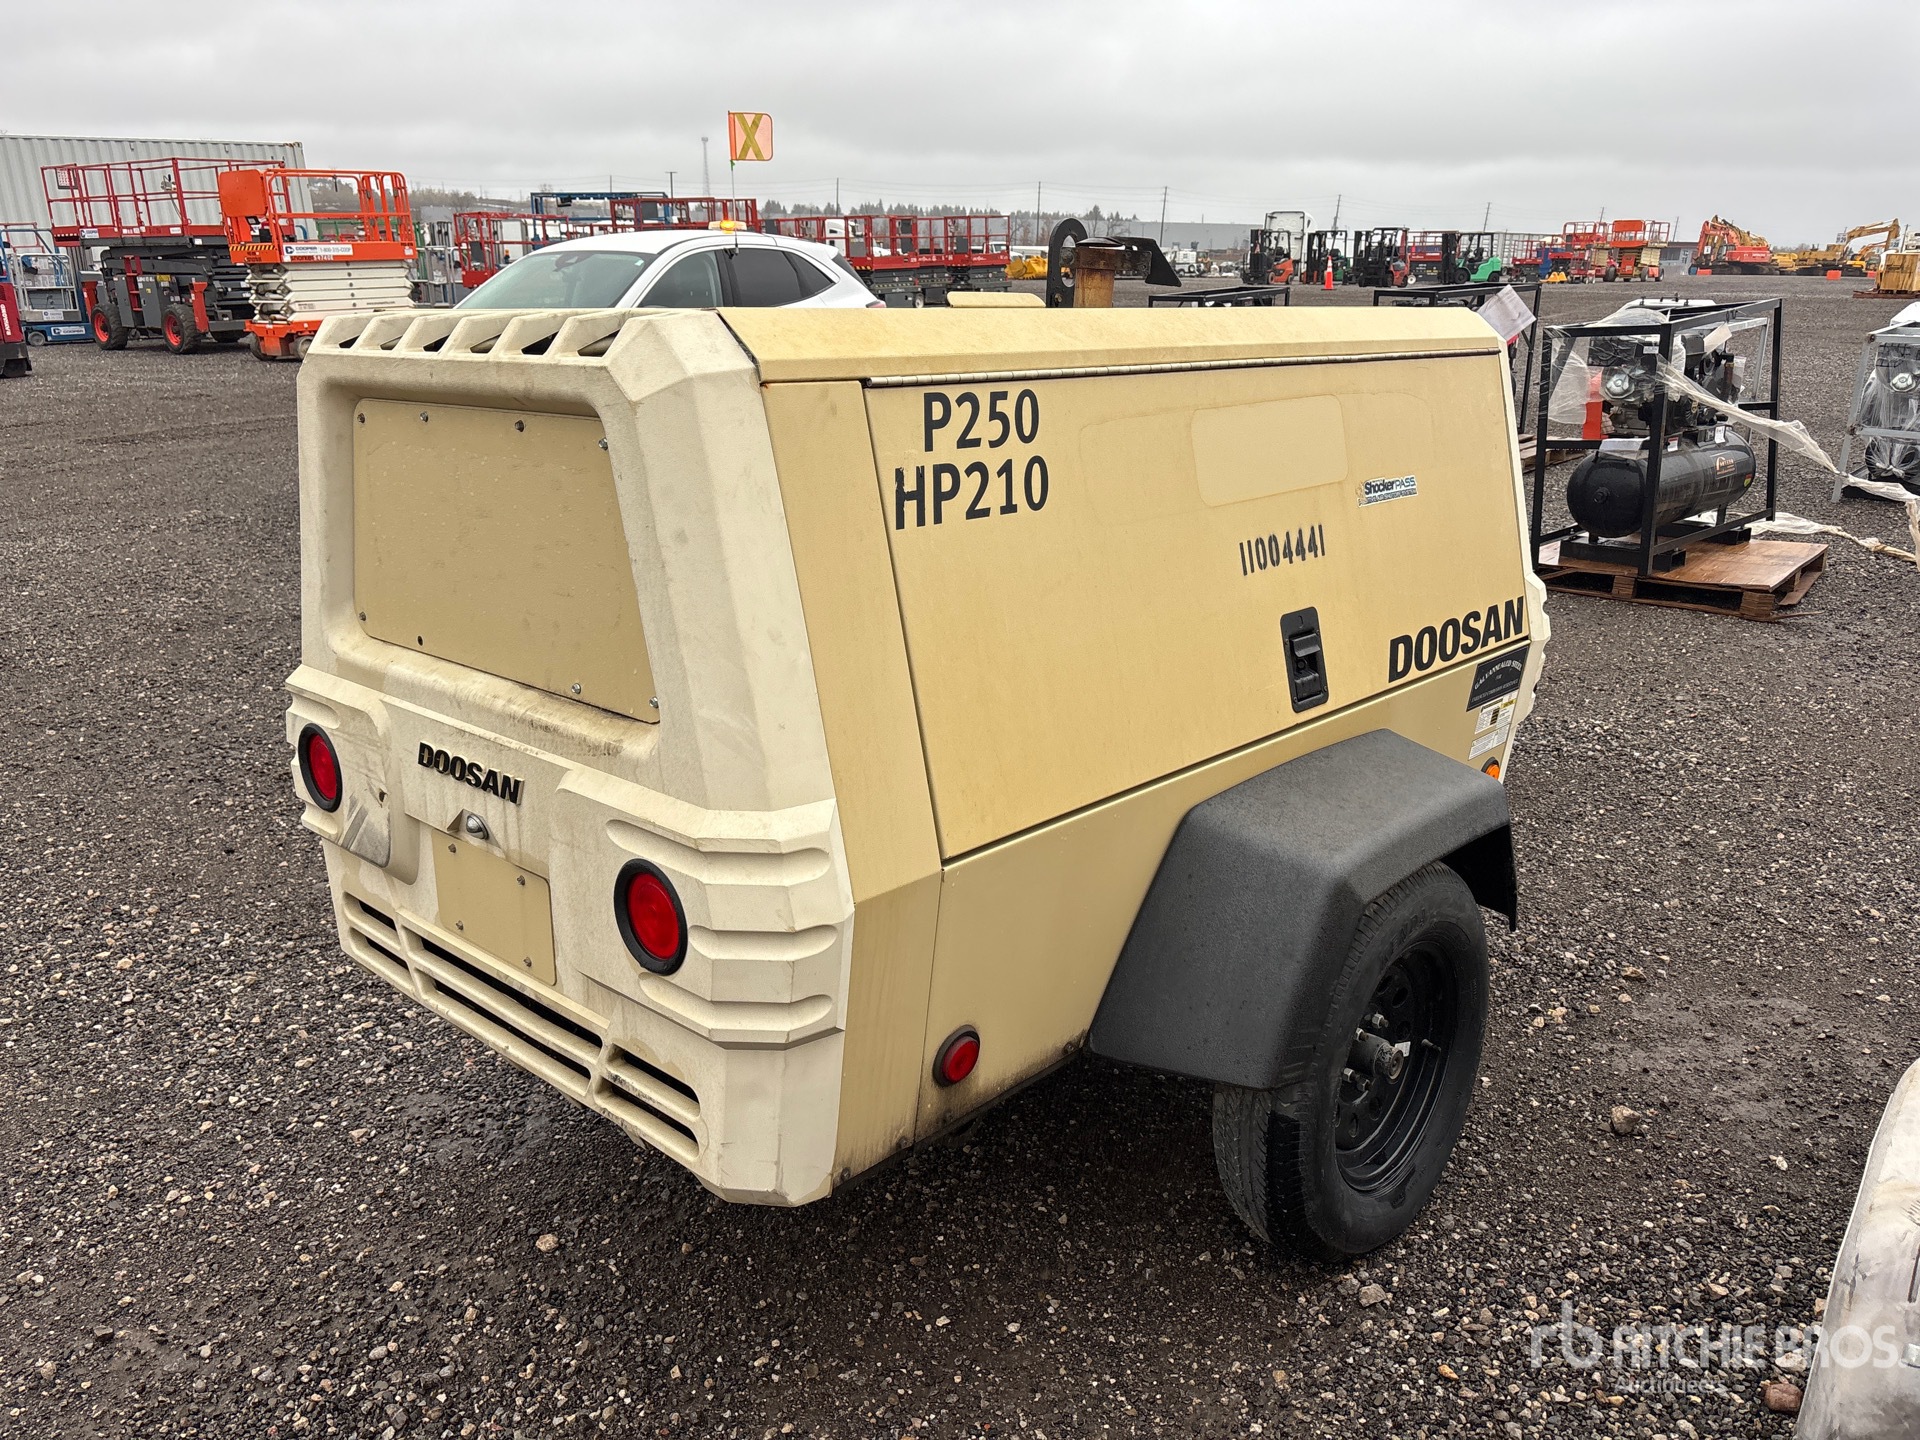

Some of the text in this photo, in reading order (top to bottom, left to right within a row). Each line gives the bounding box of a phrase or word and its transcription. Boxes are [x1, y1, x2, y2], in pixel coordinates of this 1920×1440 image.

[0, 304, 11, 336] RAYMOND
[924, 389, 1039, 452] P250
[895, 455, 1049, 530] HP210
[1239, 524, 1325, 576] 11004441
[1388, 596, 1524, 683] DOOSAN
[418, 741, 524, 805] DOOSAN
